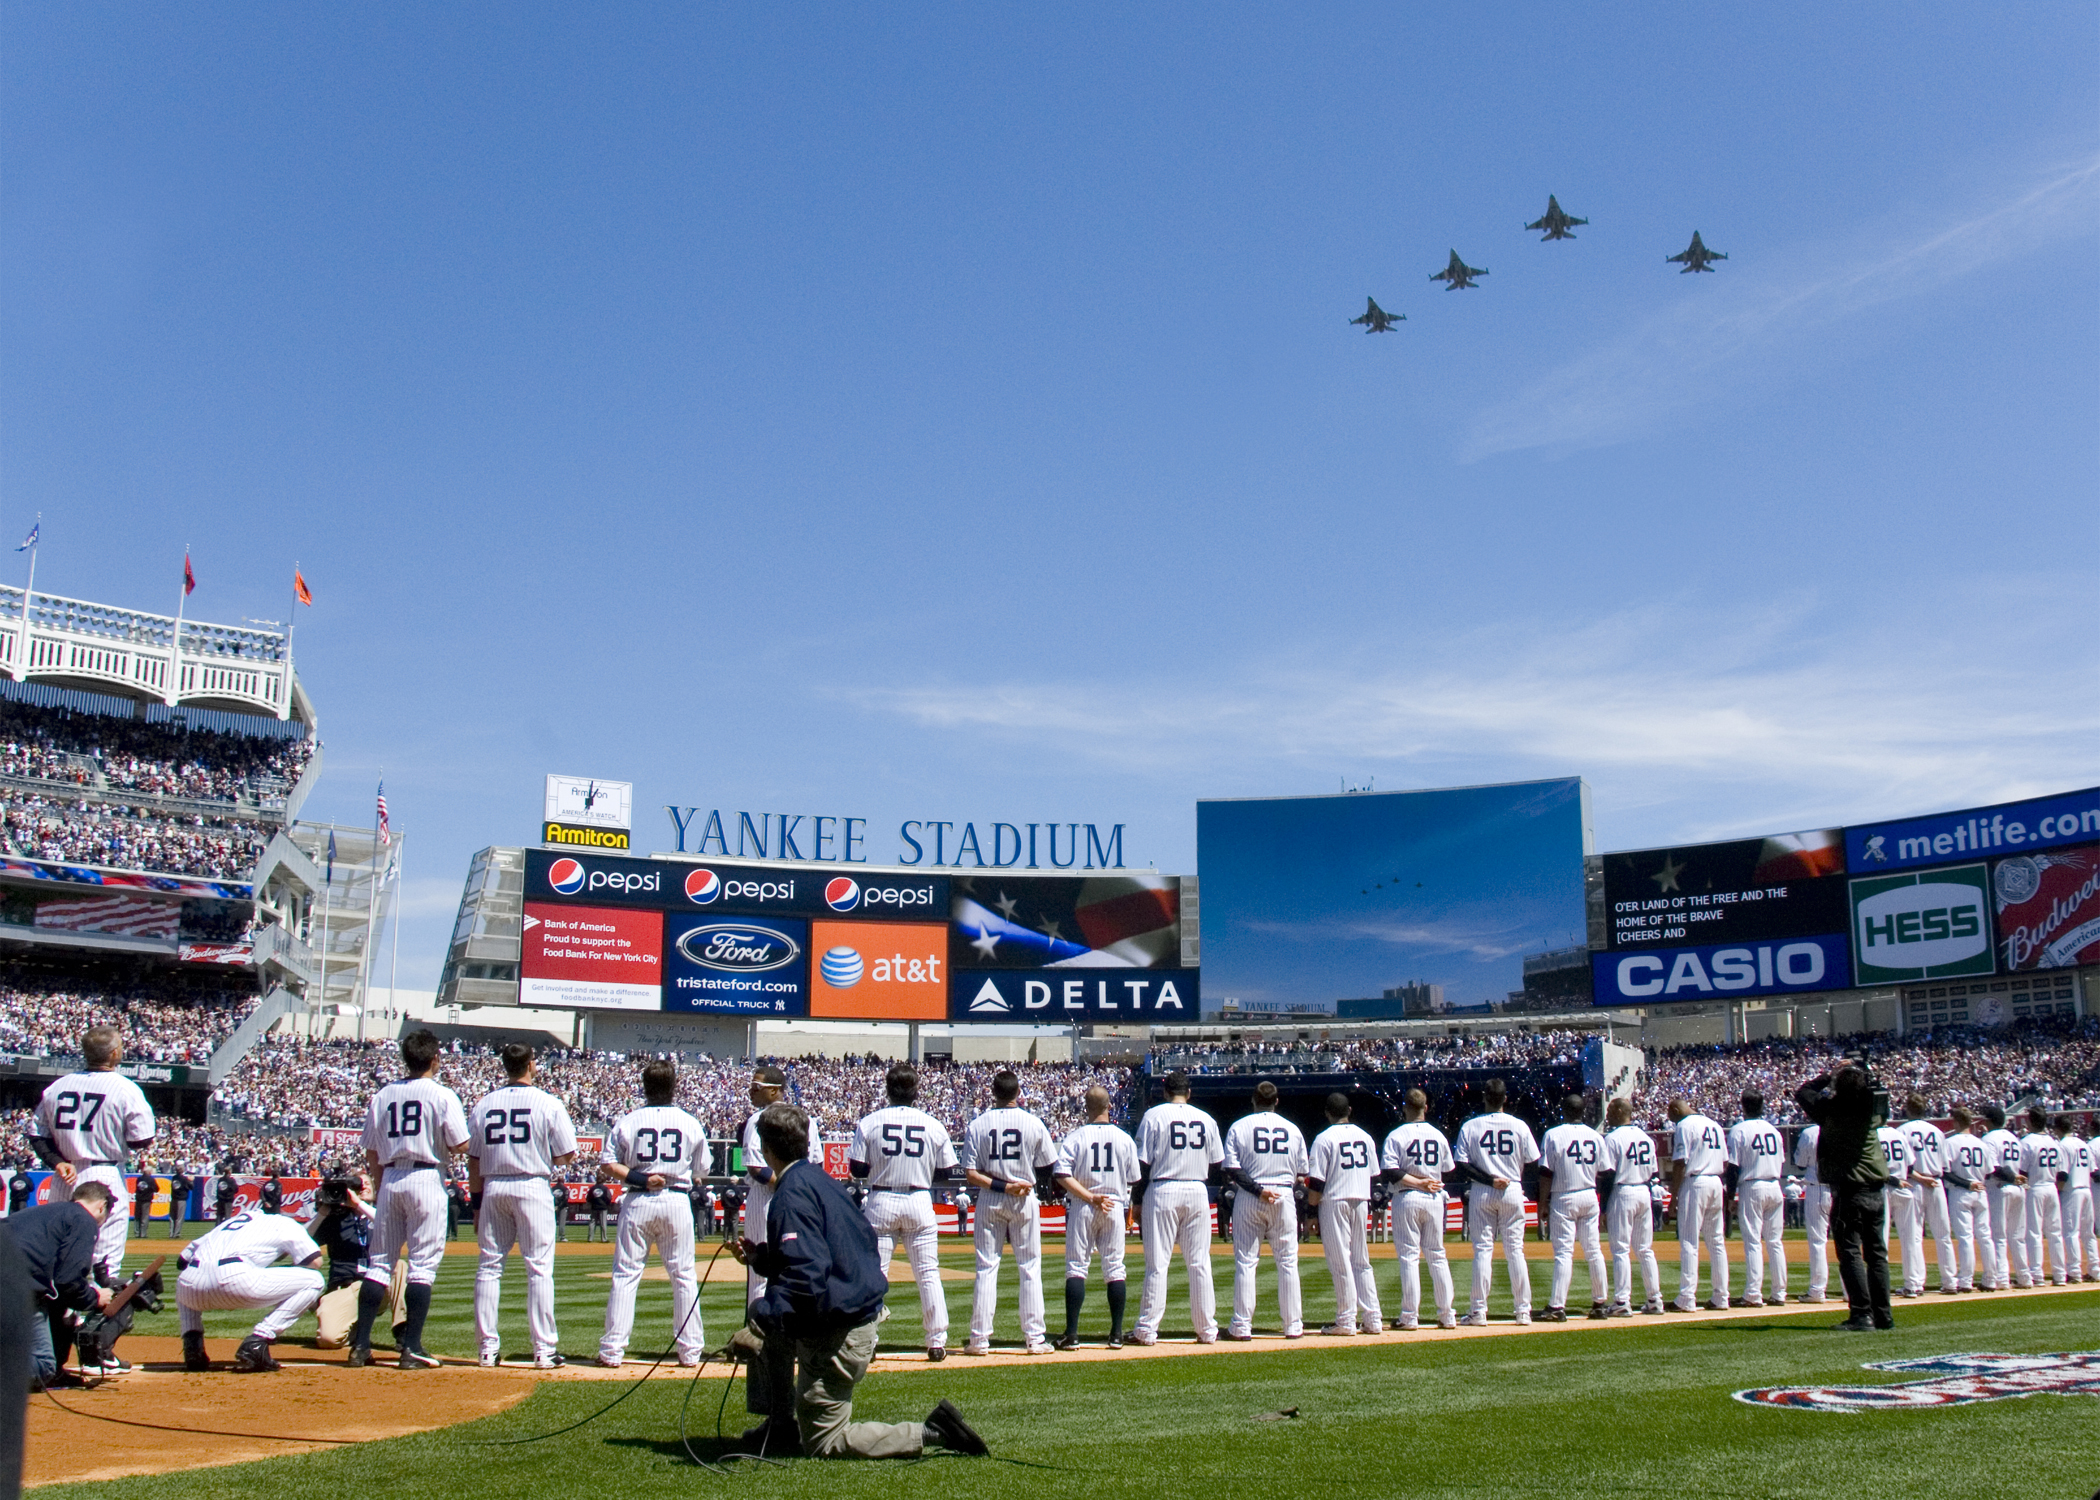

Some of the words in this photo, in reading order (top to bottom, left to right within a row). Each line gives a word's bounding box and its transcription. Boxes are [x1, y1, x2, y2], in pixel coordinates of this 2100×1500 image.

[595, 812, 617, 820] WATCH
[547, 823, 629, 849] Armitron
[664, 805, 867, 863] YANKEE
[899, 820, 1127, 869] STADIUM
[589, 871, 660, 893] pepsi
[724, 880, 795, 902] pepsi
[864, 885, 933, 908] pepsi
[1615, 901, 1639, 913] O'ER
[1641, 899, 1669, 911] LAND
[1671, 897, 1686, 909] OF
[1688, 895, 1710, 907] THE
[1712, 893, 1739, 904] FREE
[1740, 890, 1764, 902] AND
[1766, 887, 1788, 898] THE
[544, 919, 567, 929] Bank
[568, 921, 579, 930] of
[580, 922, 616, 932] America
[1616, 916, 1647, 928] HOME
[1649, 915, 1664, 926] OF
[1666, 913, 1688, 924] THE
[1690, 909, 1724, 922] BRAVE
[1865, 904, 1979, 947] HESS
[544, 933, 570, 943] Proud
[571, 935, 581, 944] to
[582, 937, 615, 947] support
[617, 938, 632, 948] the
[1664, 927, 1686, 939] AND
[178, 946, 245, 961] Budweiser
[543, 948, 564, 957] Food
[565, 949, 587, 959] Bank
[588, 951, 602, 960] For
[603, 951, 622, 961] New
[622, 953, 641, 962] York
[642, 954, 658, 965] City
[704, 932, 772, 963] Ford
[872, 953, 941, 984] at&t
[1617, 942, 1826, 997] CASIO
[531, 984, 544, 992] Get
[545, 984, 573, 993] involved
[574, 986, 588, 994] and
[588, 987, 609, 995] make
[676, 976, 798, 993] tristateford.com
[1025, 980, 1184, 1010] DELTA
[561, 994, 623, 1004] foodbanknyc.org
[691, 998, 736, 1008] OFFICIAL
[736, 1000, 770, 1009] TRUCK
[1244, 1001, 1281, 1012] YANKEE
[1284, 1002, 1328, 1013] STADIUM
[636, 1034, 654, 1043] New
[654, 1034, 673, 1047] York
[115, 1064, 139, 1077] land
[138, 1064, 172, 1082] Spring
[55, 1090, 107, 1132] 27
[387, 1100, 422, 1138] 18
[485, 1108, 532, 1145] 25
[1170, 1120, 1206, 1150] 63
[1702, 1126, 1721, 1150] 41
[636, 1127, 683, 1163] 33
[882, 1123, 925, 1158] 55
[988, 1128, 1022, 1160] 12
[1253, 1126, 1289, 1155] 62
[1479, 1129, 1514, 1156] 46
[1566, 1139, 1597, 1165] 43
[1751, 1132, 1778, 1156] 40
[1910, 1131, 1938, 1152] 34
[2002, 1140, 2020, 1161] 26
[1090, 1142, 1114, 1172] 11
[1339, 1140, 1369, 1170] 53
[1406, 1139, 1440, 1166] 48
[1626, 1140, 1651, 1166] 42
[1959, 1146, 1983, 1168] 30
[2038, 1147, 2058, 1168] 22
[2075, 1147, 2088, 1168] 19
[221, 1212, 253, 1232] 2
[574, 1213, 592, 1221] STRIK
